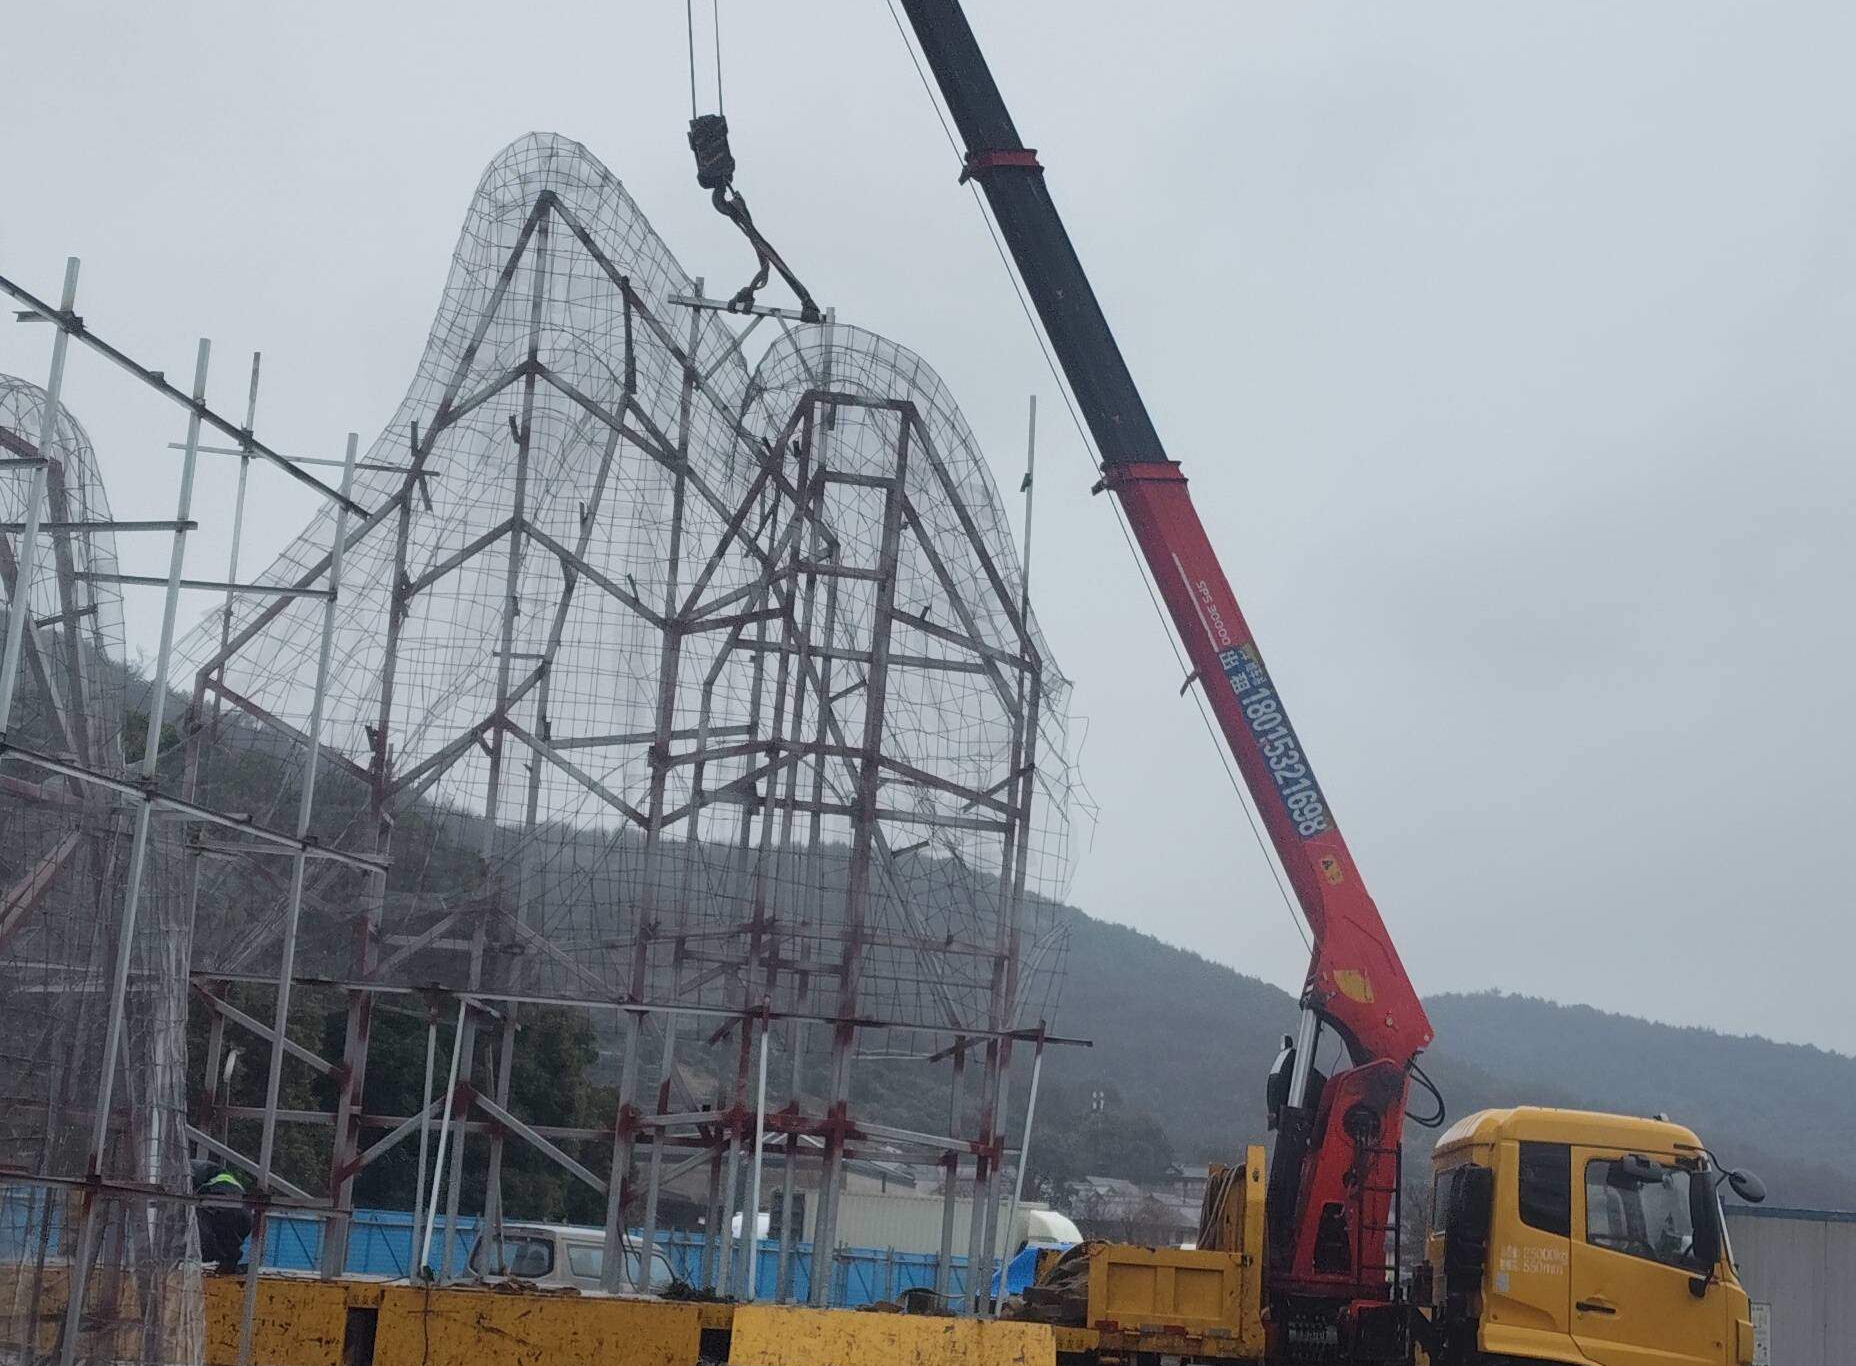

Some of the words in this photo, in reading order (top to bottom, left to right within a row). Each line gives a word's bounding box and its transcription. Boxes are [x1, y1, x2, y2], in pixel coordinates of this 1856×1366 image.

[1196, 580, 1213, 603] SPS
[1207, 604, 1231, 645] 30000
[1219, 649, 1251, 694] 出租
[1243, 688, 1326, 836] 18015321698
